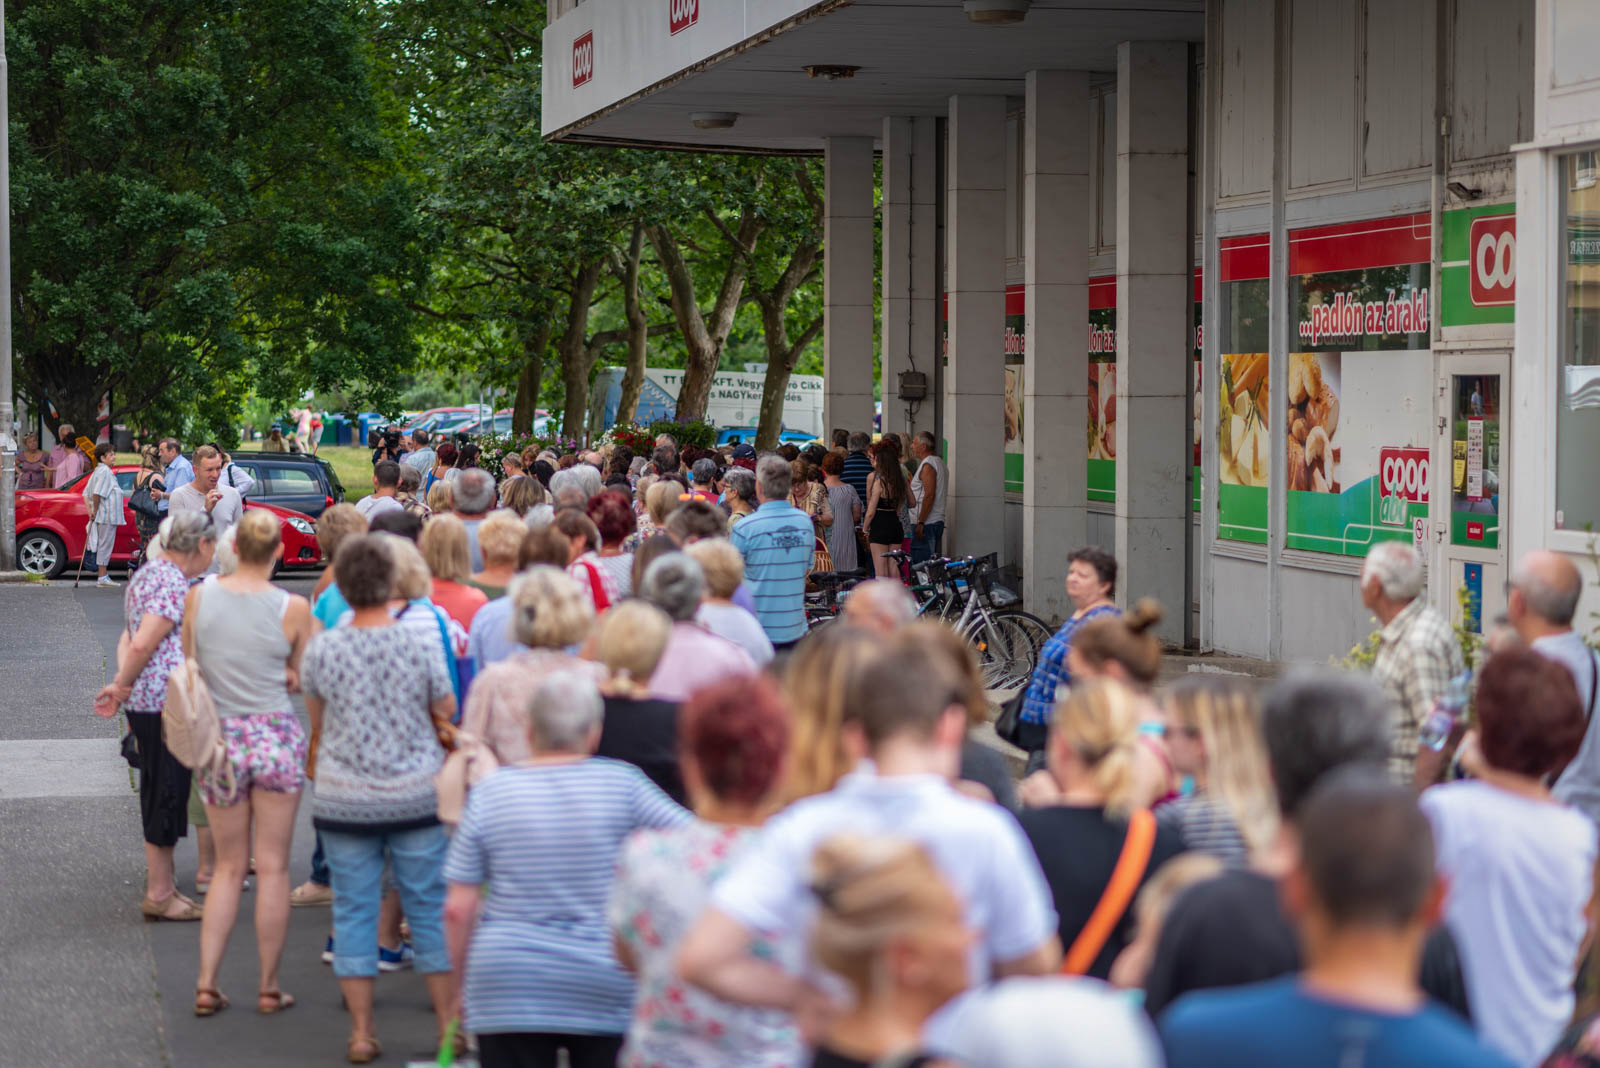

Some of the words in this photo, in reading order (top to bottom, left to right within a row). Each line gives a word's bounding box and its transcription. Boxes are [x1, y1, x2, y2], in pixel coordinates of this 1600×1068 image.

[574, 41, 592, 80] coop
[1477, 231, 1516, 290] co
[1365, 301, 1384, 335] az
[1386, 289, 1428, 334] árak!
[663, 375, 677, 385] TT
[800, 381, 822, 391] Cikk
[1383, 457, 1429, 503] coop
